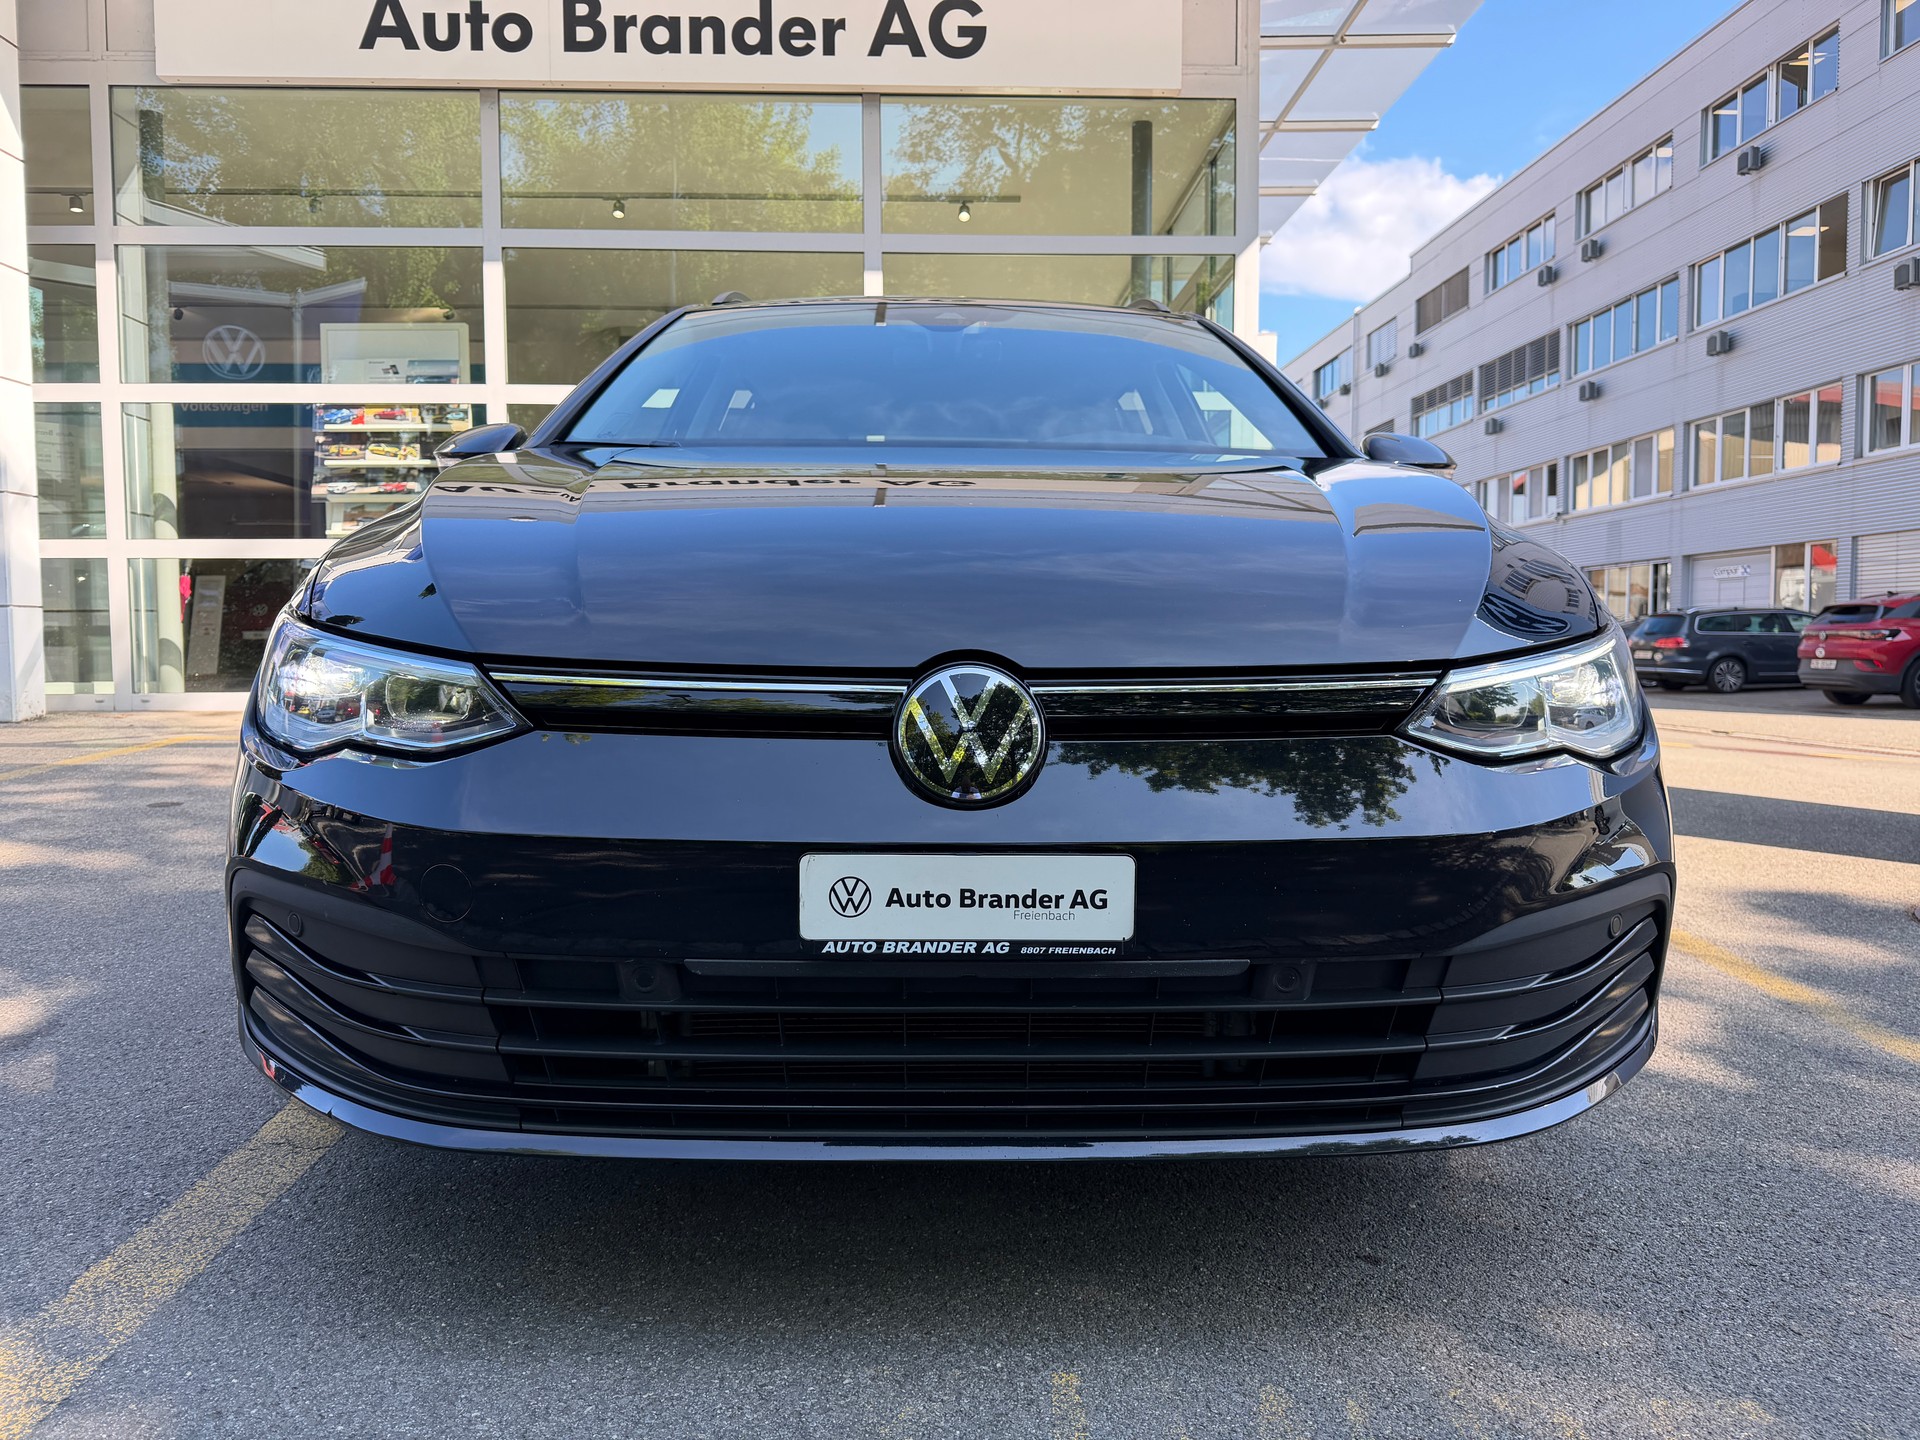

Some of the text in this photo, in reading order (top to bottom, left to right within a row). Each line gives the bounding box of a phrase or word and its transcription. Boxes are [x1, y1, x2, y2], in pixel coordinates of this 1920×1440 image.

[358, 0, 988, 59] Auto Brander AG
[885, 887, 952, 909] Auto
[959, 888, 1065, 909] Brander
[1069, 889, 1108, 910] AG
[1013, 909, 1076, 921] Freienbach
[821, 941, 1117, 955] AUTO BRANDER AG 8807 FREIENBACH
